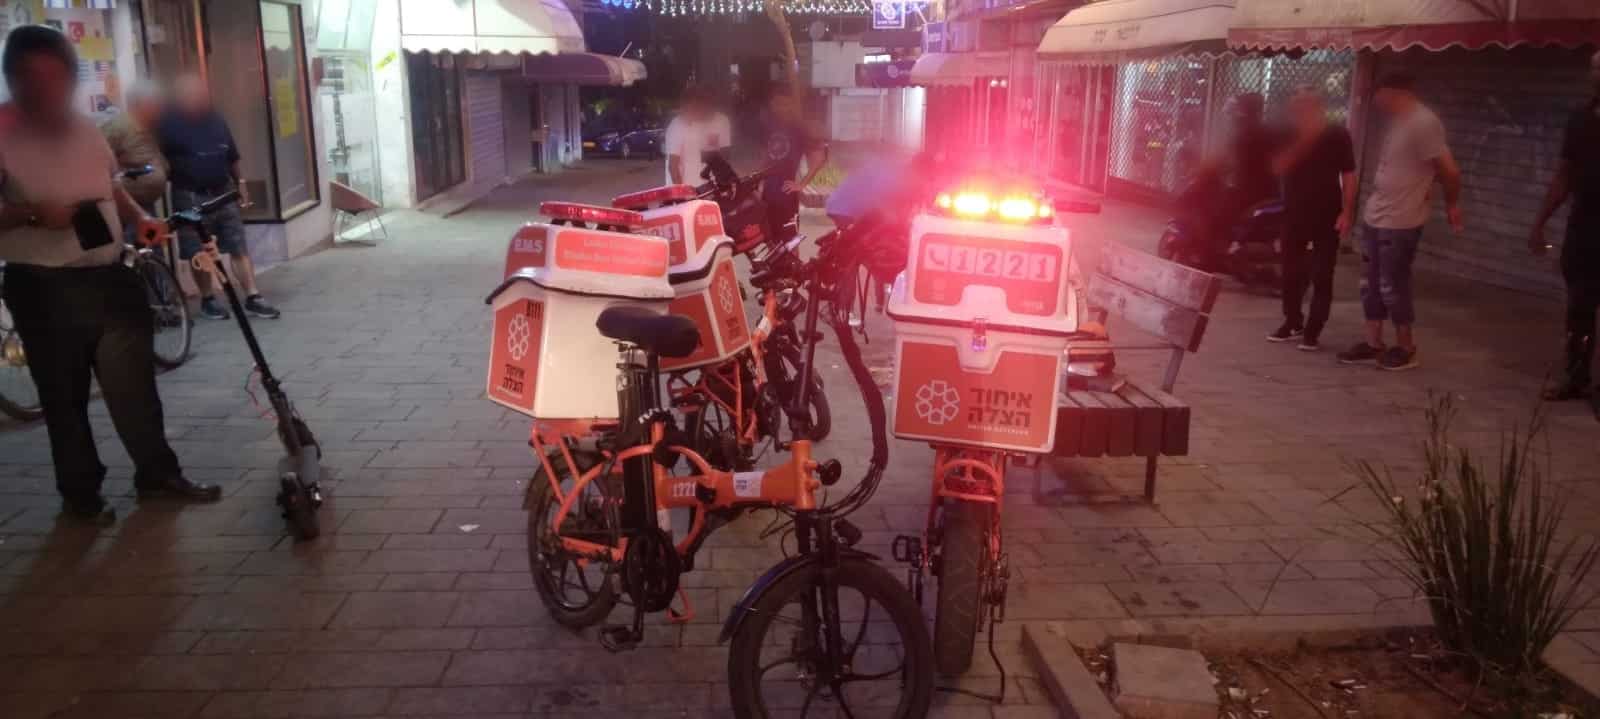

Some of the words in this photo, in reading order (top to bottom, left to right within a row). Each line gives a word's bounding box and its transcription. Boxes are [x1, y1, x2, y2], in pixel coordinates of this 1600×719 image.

[956, 248, 1048, 279] 1221
[968, 387, 1032, 409] איחוד
[967, 405, 1031, 428] הצלה
